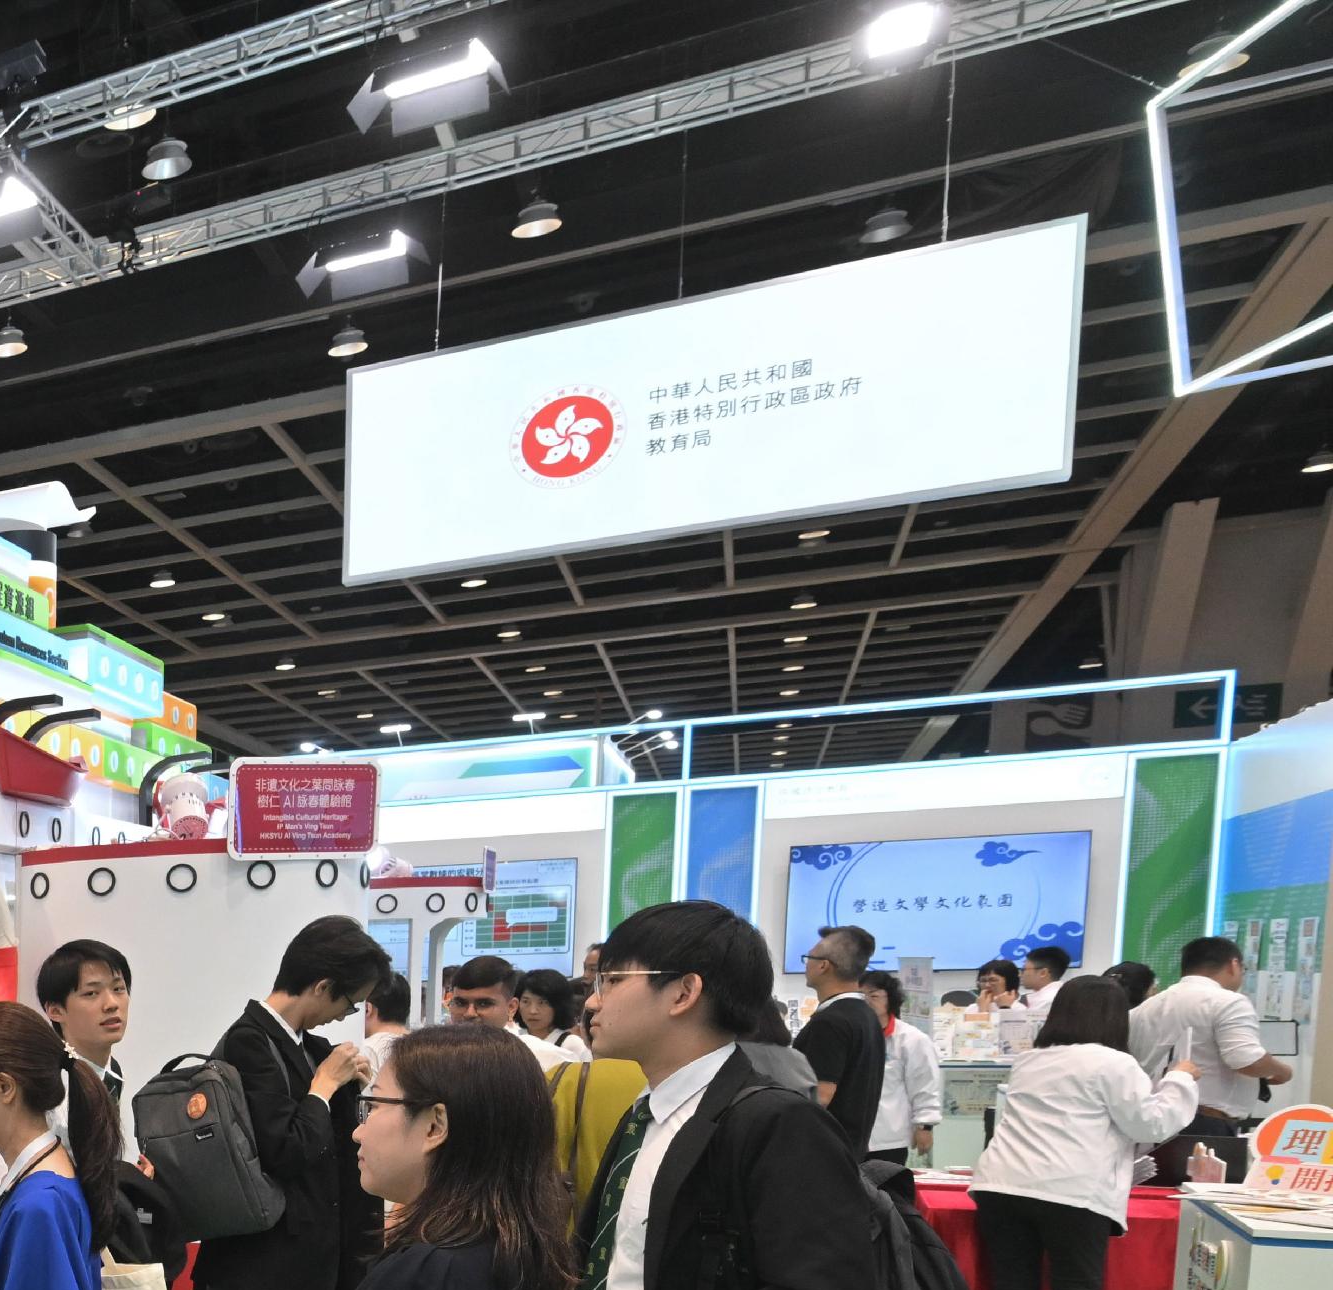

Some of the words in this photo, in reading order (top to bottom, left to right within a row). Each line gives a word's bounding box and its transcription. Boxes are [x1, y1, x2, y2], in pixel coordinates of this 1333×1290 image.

[649, 358, 813, 404] 中華人民共和國
[647, 376, 863, 430] 香港特別行政區政府
[645, 429, 712, 456] 教育局
[852, 893, 1014, 914] 營造文學文化氛圍
